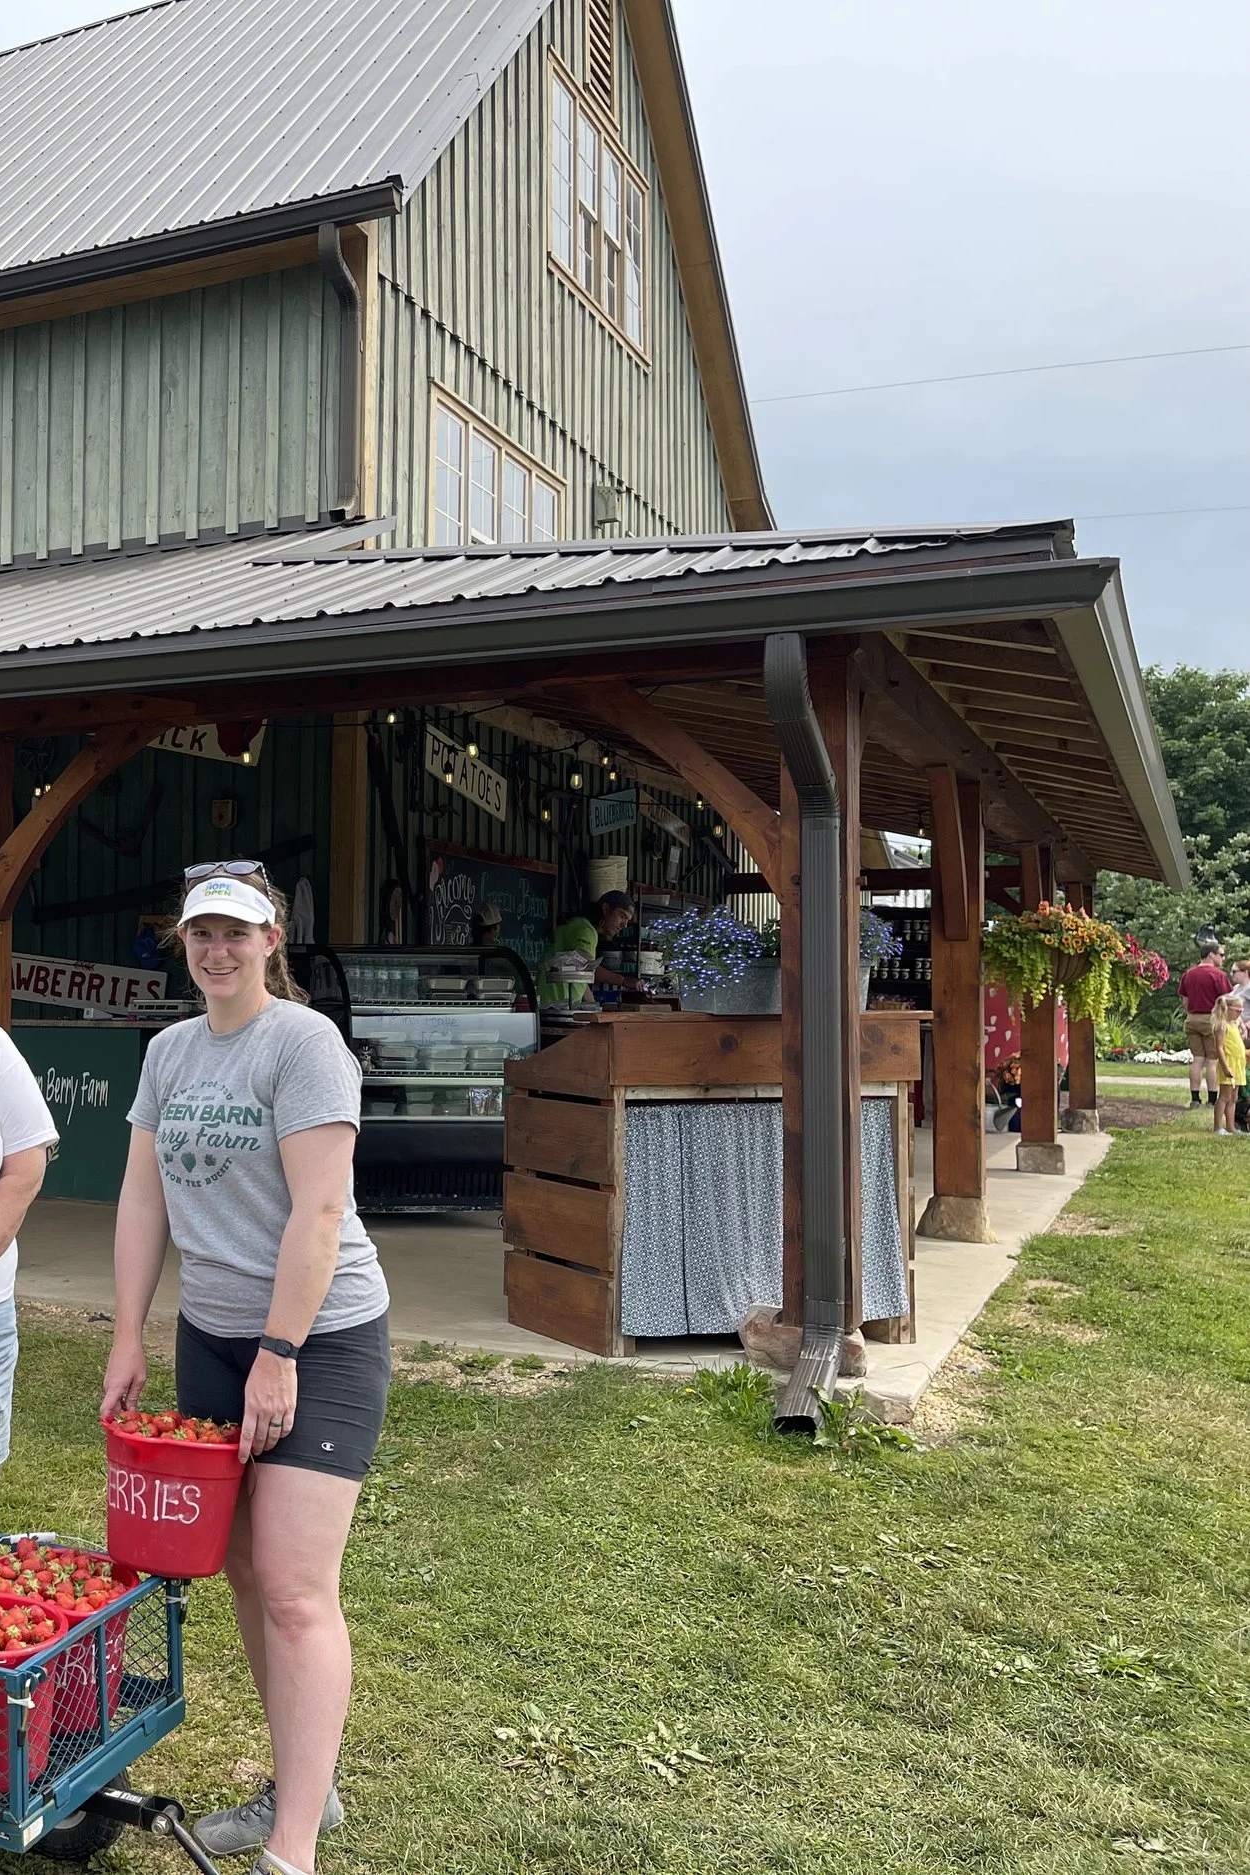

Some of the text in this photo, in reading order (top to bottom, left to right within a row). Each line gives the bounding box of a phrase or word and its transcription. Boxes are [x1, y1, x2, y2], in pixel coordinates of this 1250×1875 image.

[430, 734, 502, 812] POTATOES
[46, 1067, 110, 1126] Berry Farm
[199, 1104, 263, 1127] BARN
[195, 1121, 261, 1152] Farm
[185, 1179, 203, 1188] THE
[204, 1157, 233, 1186] BUCKET
[108, 1466, 202, 1525] ERRIES
